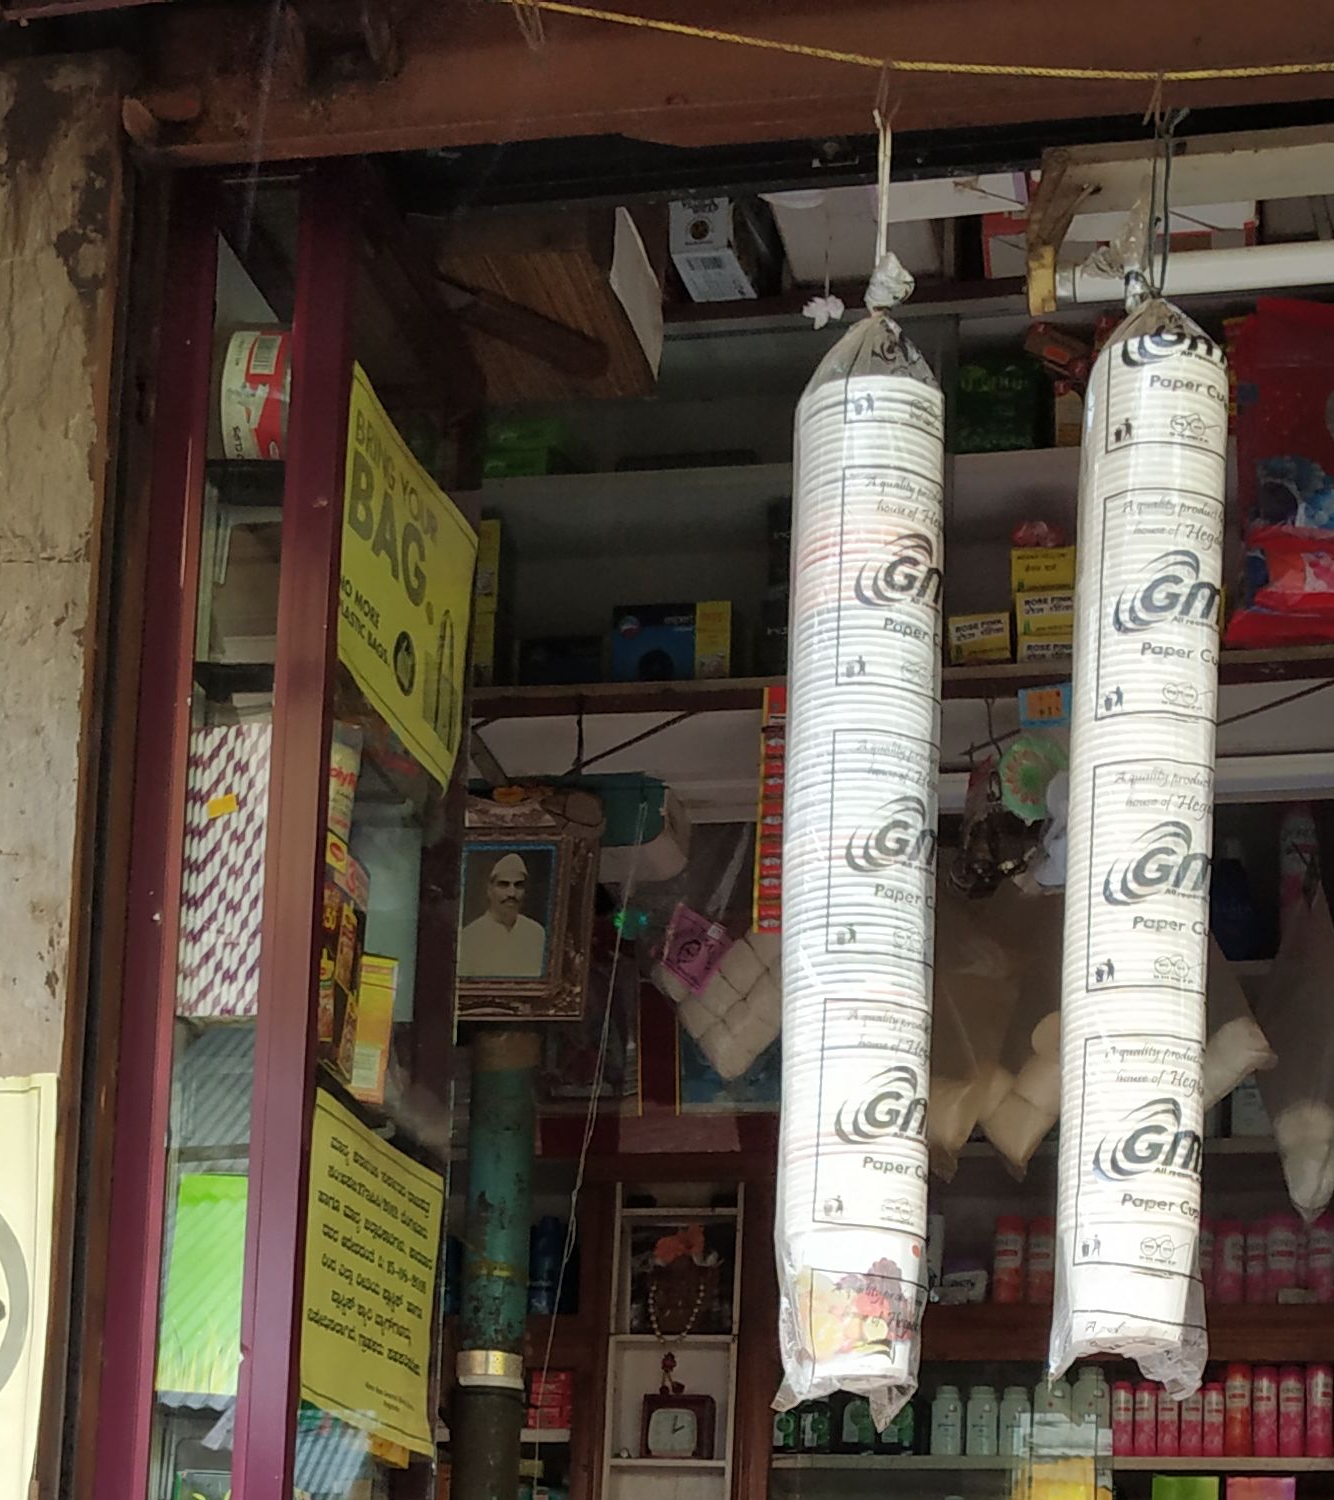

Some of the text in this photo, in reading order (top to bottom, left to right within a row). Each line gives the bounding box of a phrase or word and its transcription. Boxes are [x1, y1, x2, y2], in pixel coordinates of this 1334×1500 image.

[1149, 374, 1203, 392] Paper
[341, 603, 366, 642] LASTIC
[883, 616, 930, 642] Paper
[1140, 641, 1195, 660] Paper
[873, 882, 922, 905] Paper
[1132, 915, 1185, 933] Paper
[861, 1155, 911, 1176] Paper
[1121, 1192, 1177, 1213] Paper
